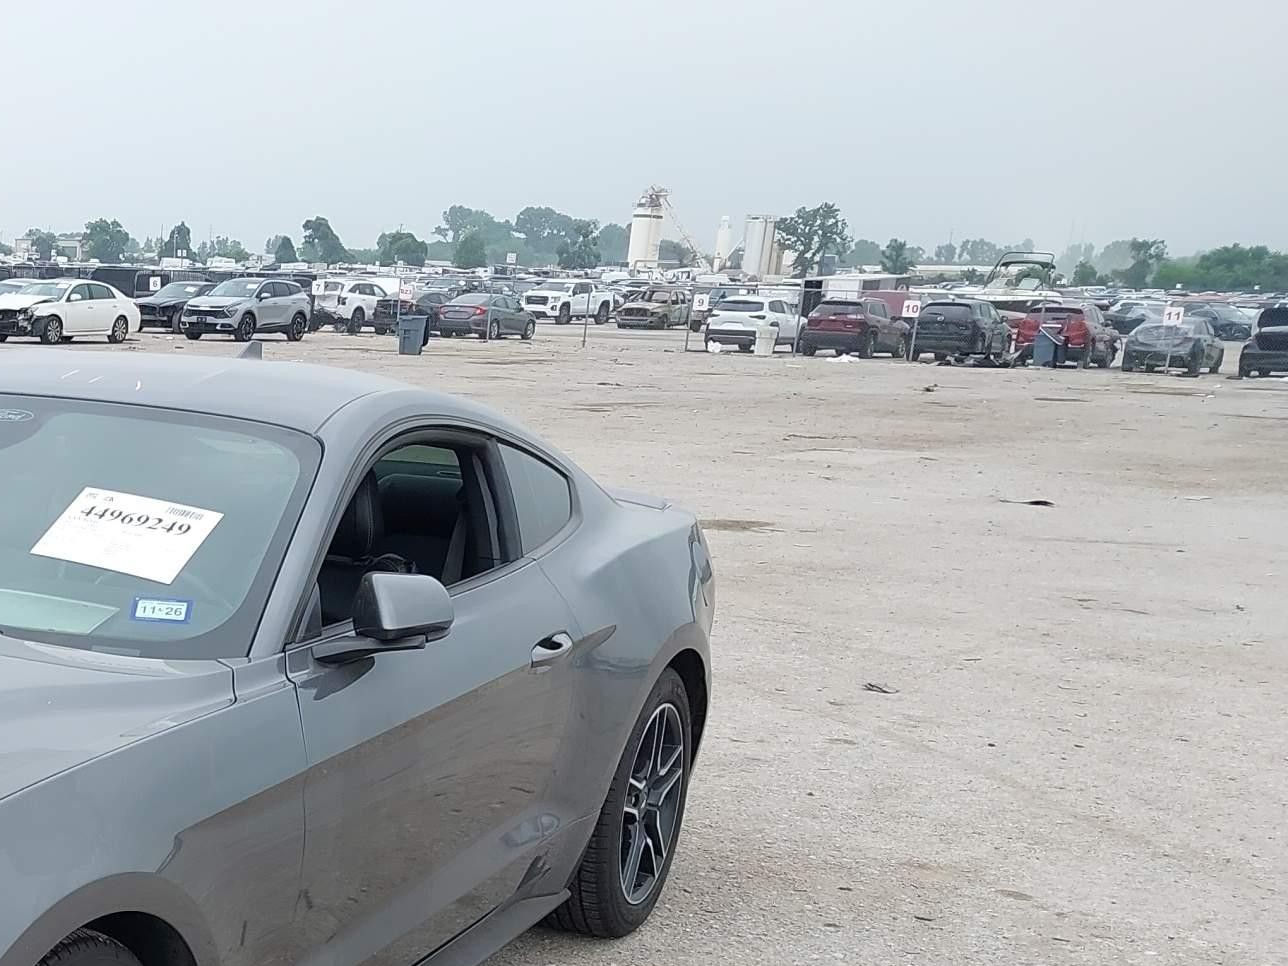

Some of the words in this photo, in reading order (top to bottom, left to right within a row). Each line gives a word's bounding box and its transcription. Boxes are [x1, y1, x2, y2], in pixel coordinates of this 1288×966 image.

[698, 298, 705, 307] 9
[905, 304, 919, 314] 10
[1166, 311, 1181, 321] 11
[80, 505, 192, 536] 44969249
